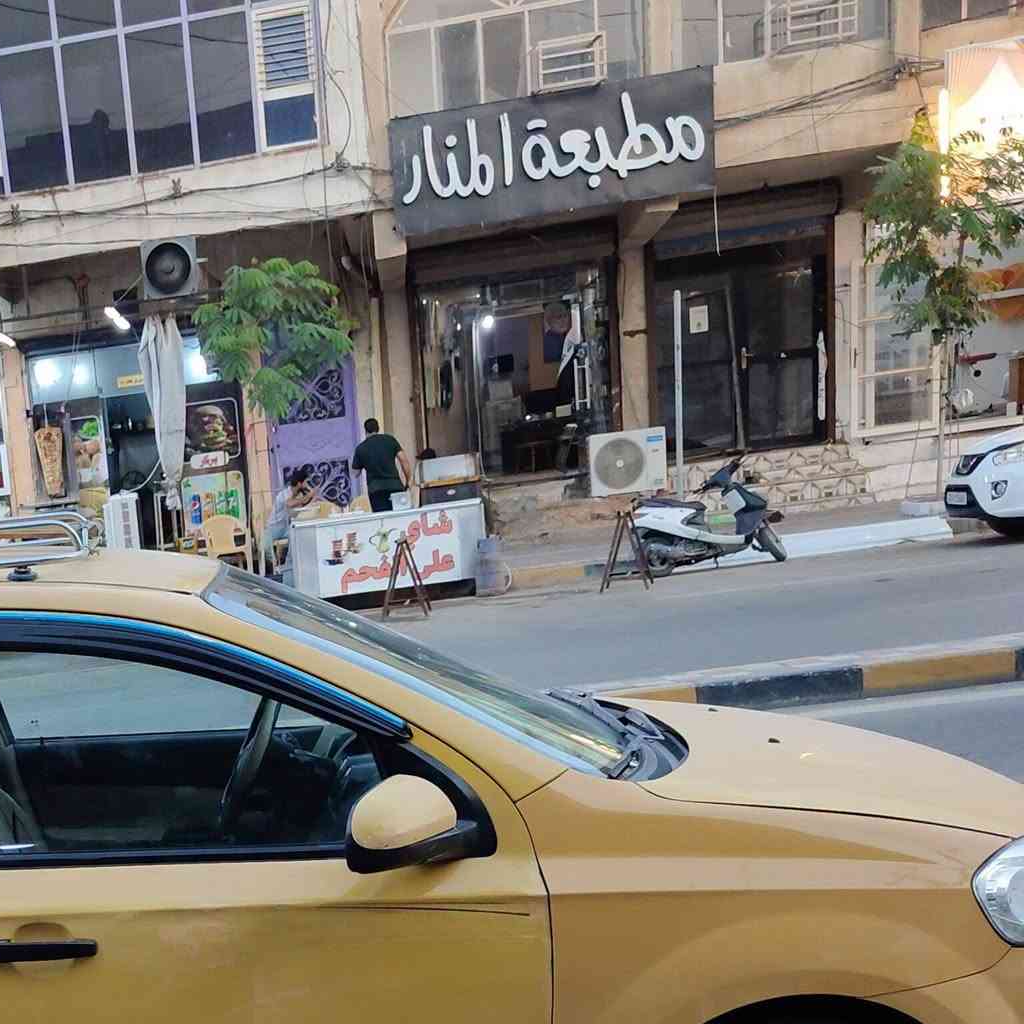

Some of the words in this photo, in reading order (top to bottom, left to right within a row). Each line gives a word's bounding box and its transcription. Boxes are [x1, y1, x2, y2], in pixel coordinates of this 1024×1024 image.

[402, 112, 514, 205] المنار
[521, 91, 705, 189] مطبعة
[407, 510, 453, 550] شاي
